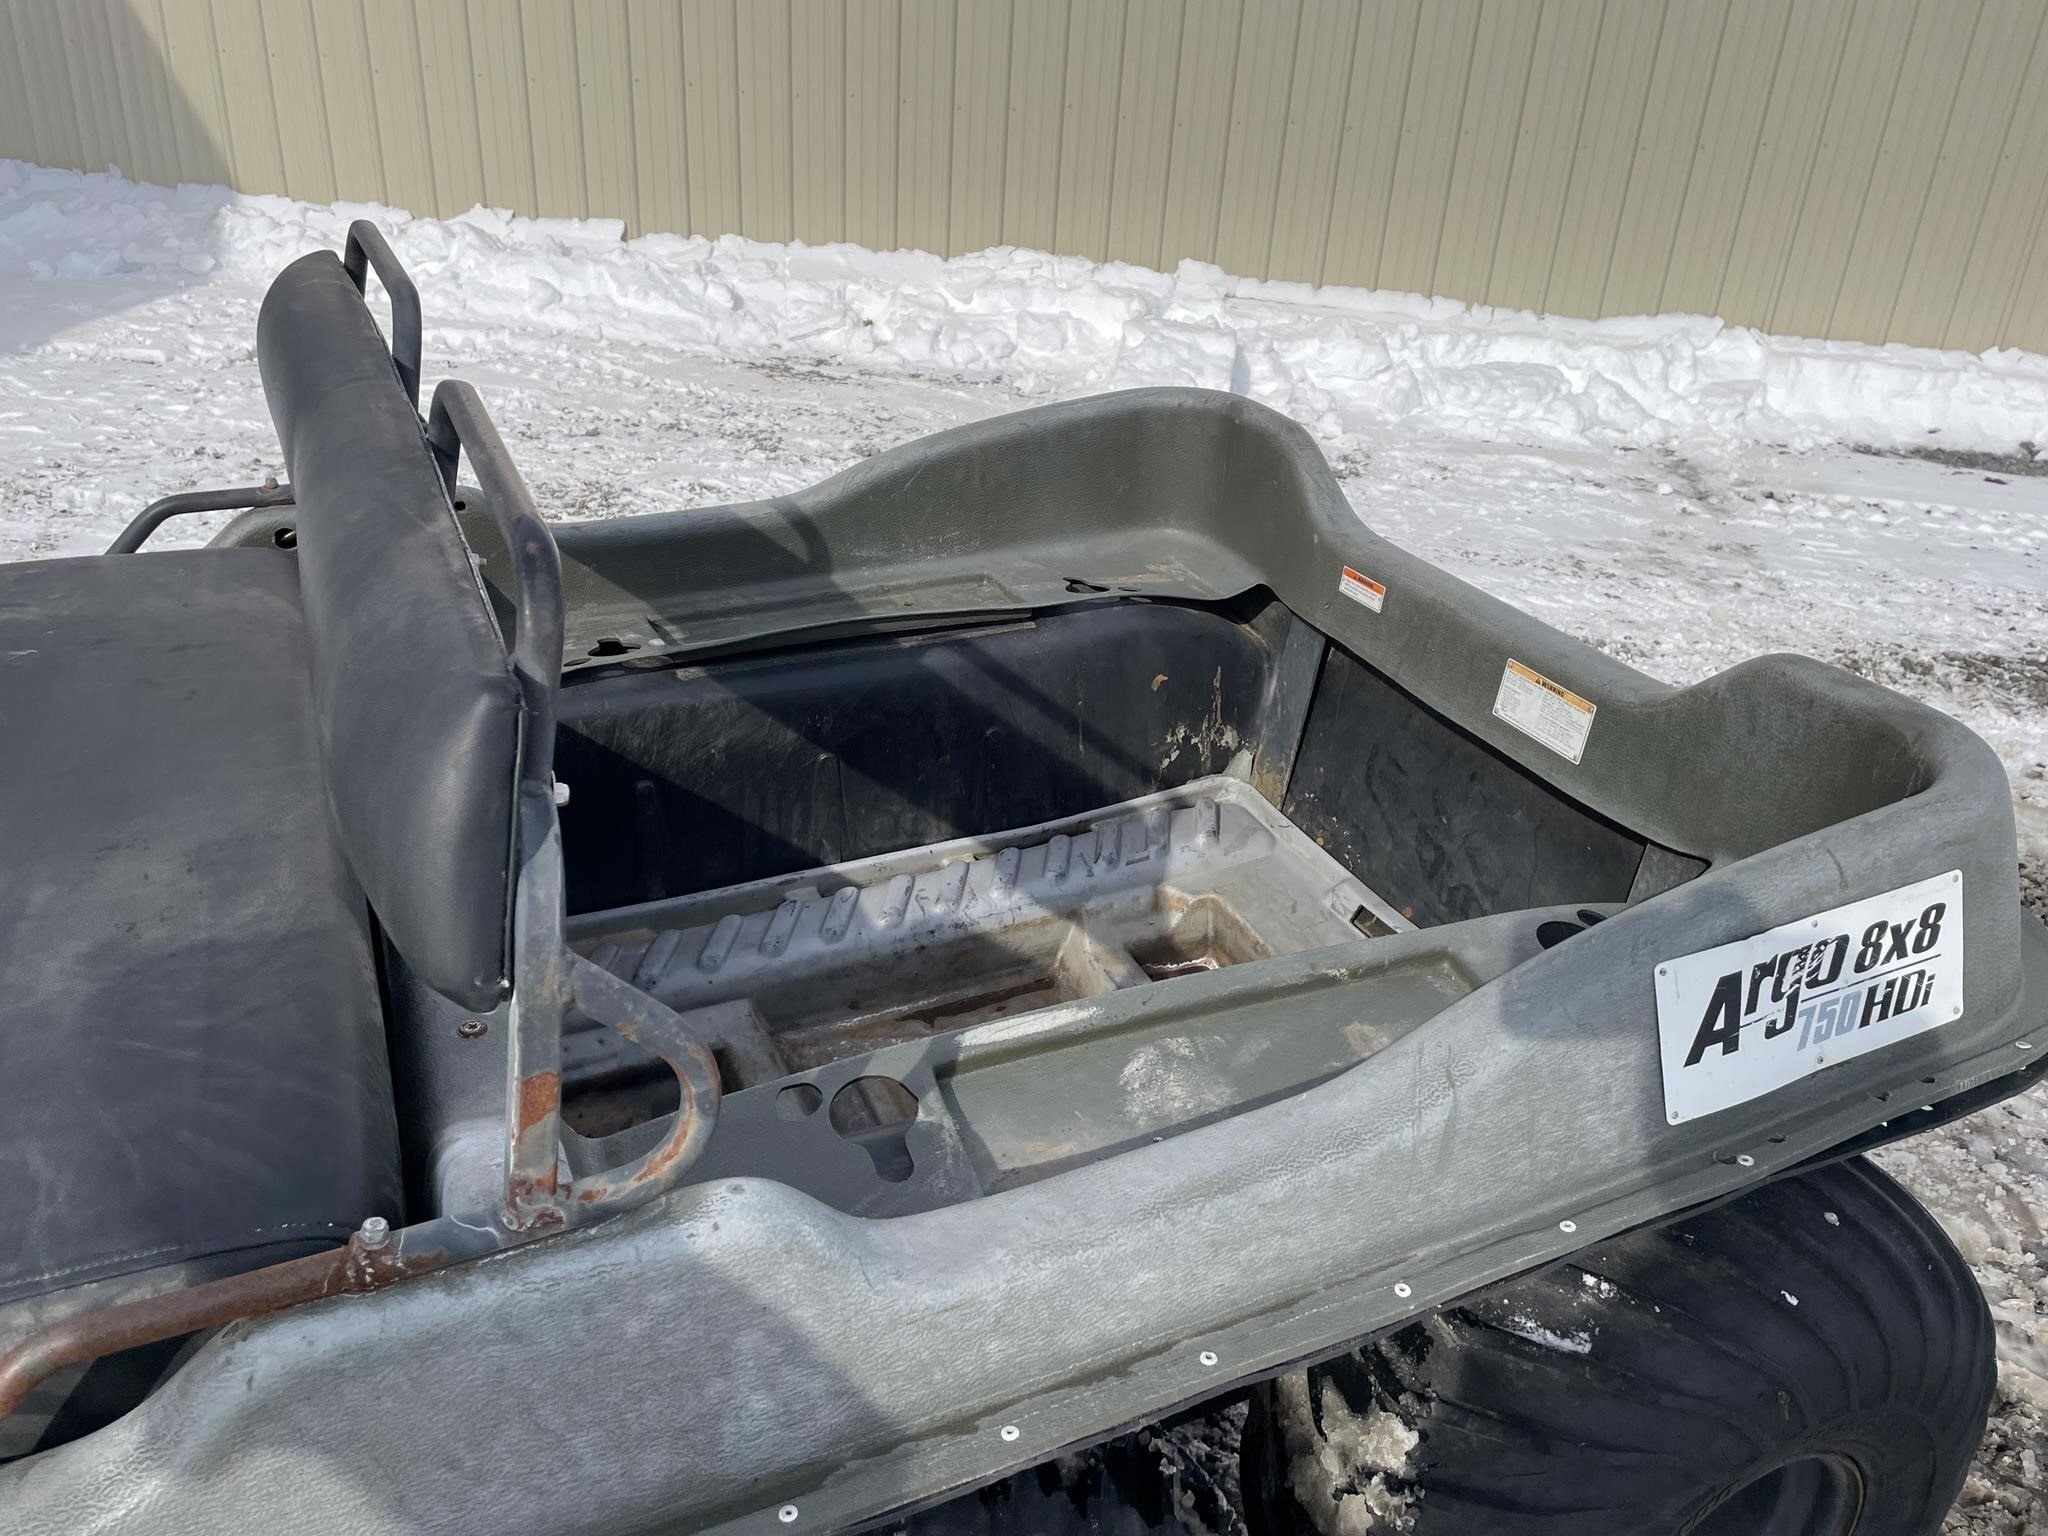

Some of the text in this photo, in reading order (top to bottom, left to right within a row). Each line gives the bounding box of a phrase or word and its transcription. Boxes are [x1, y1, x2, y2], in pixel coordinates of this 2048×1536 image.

[1541, 680, 1565, 697] WARNING
[1683, 902, 1947, 1067] Argo 8x8
